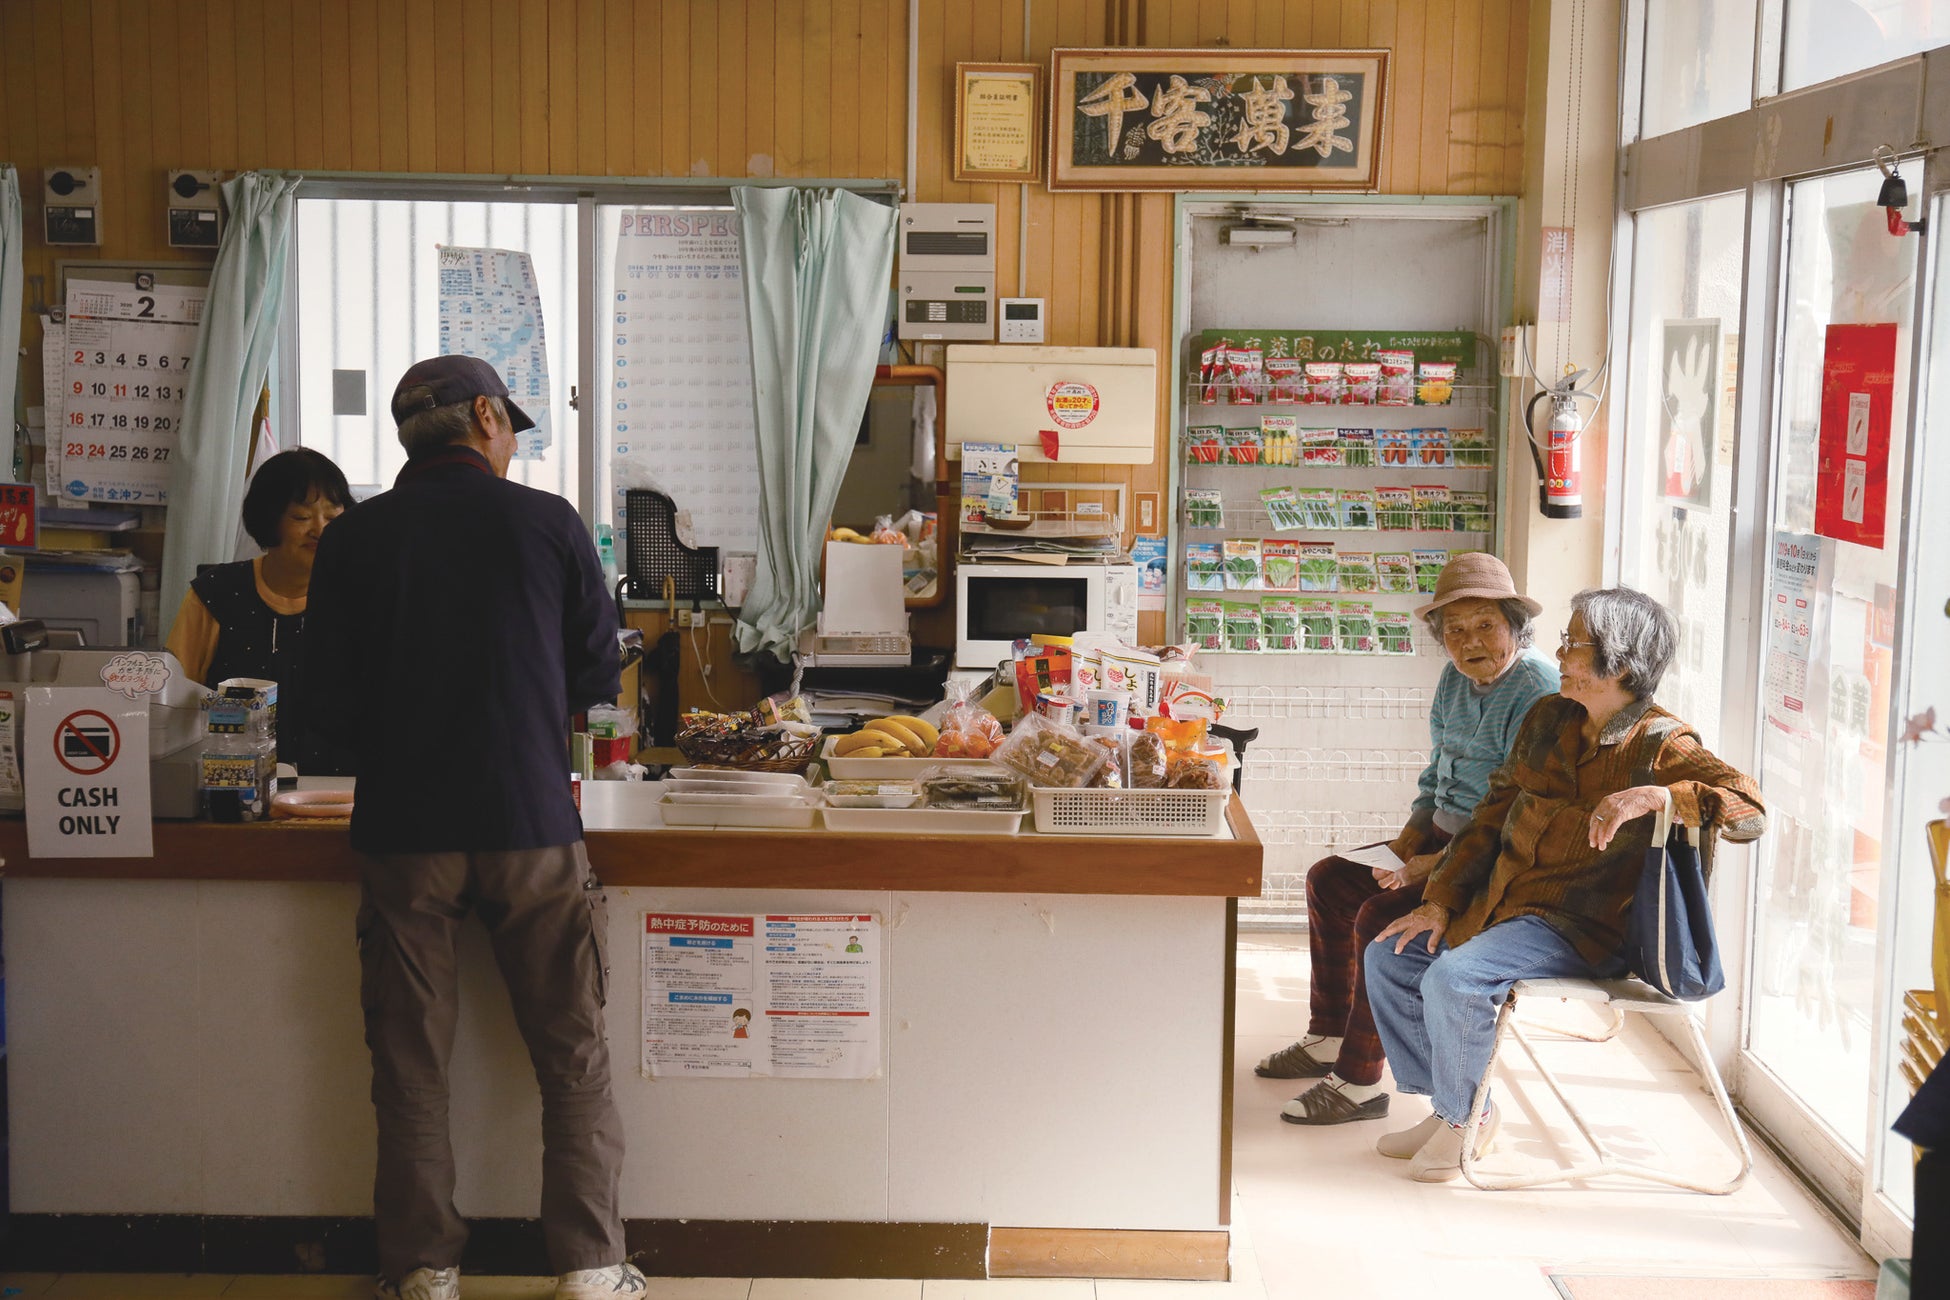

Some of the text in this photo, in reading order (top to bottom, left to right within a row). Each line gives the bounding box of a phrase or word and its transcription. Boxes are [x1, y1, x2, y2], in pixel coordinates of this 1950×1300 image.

[138, 296, 155, 318] 2
[74, 351, 190, 369] 2 3 4 5 6 7
[73, 382, 186, 400] 9 10 11 12 13 1
[69, 413, 170, 430] 16 17 18 19 20
[67, 443, 170, 460] 23 24 25 26 27
[58, 787, 118, 807] CASH
[59, 815, 120, 835] ONLY
[651, 917, 749, 933] 熱中症予防のために
